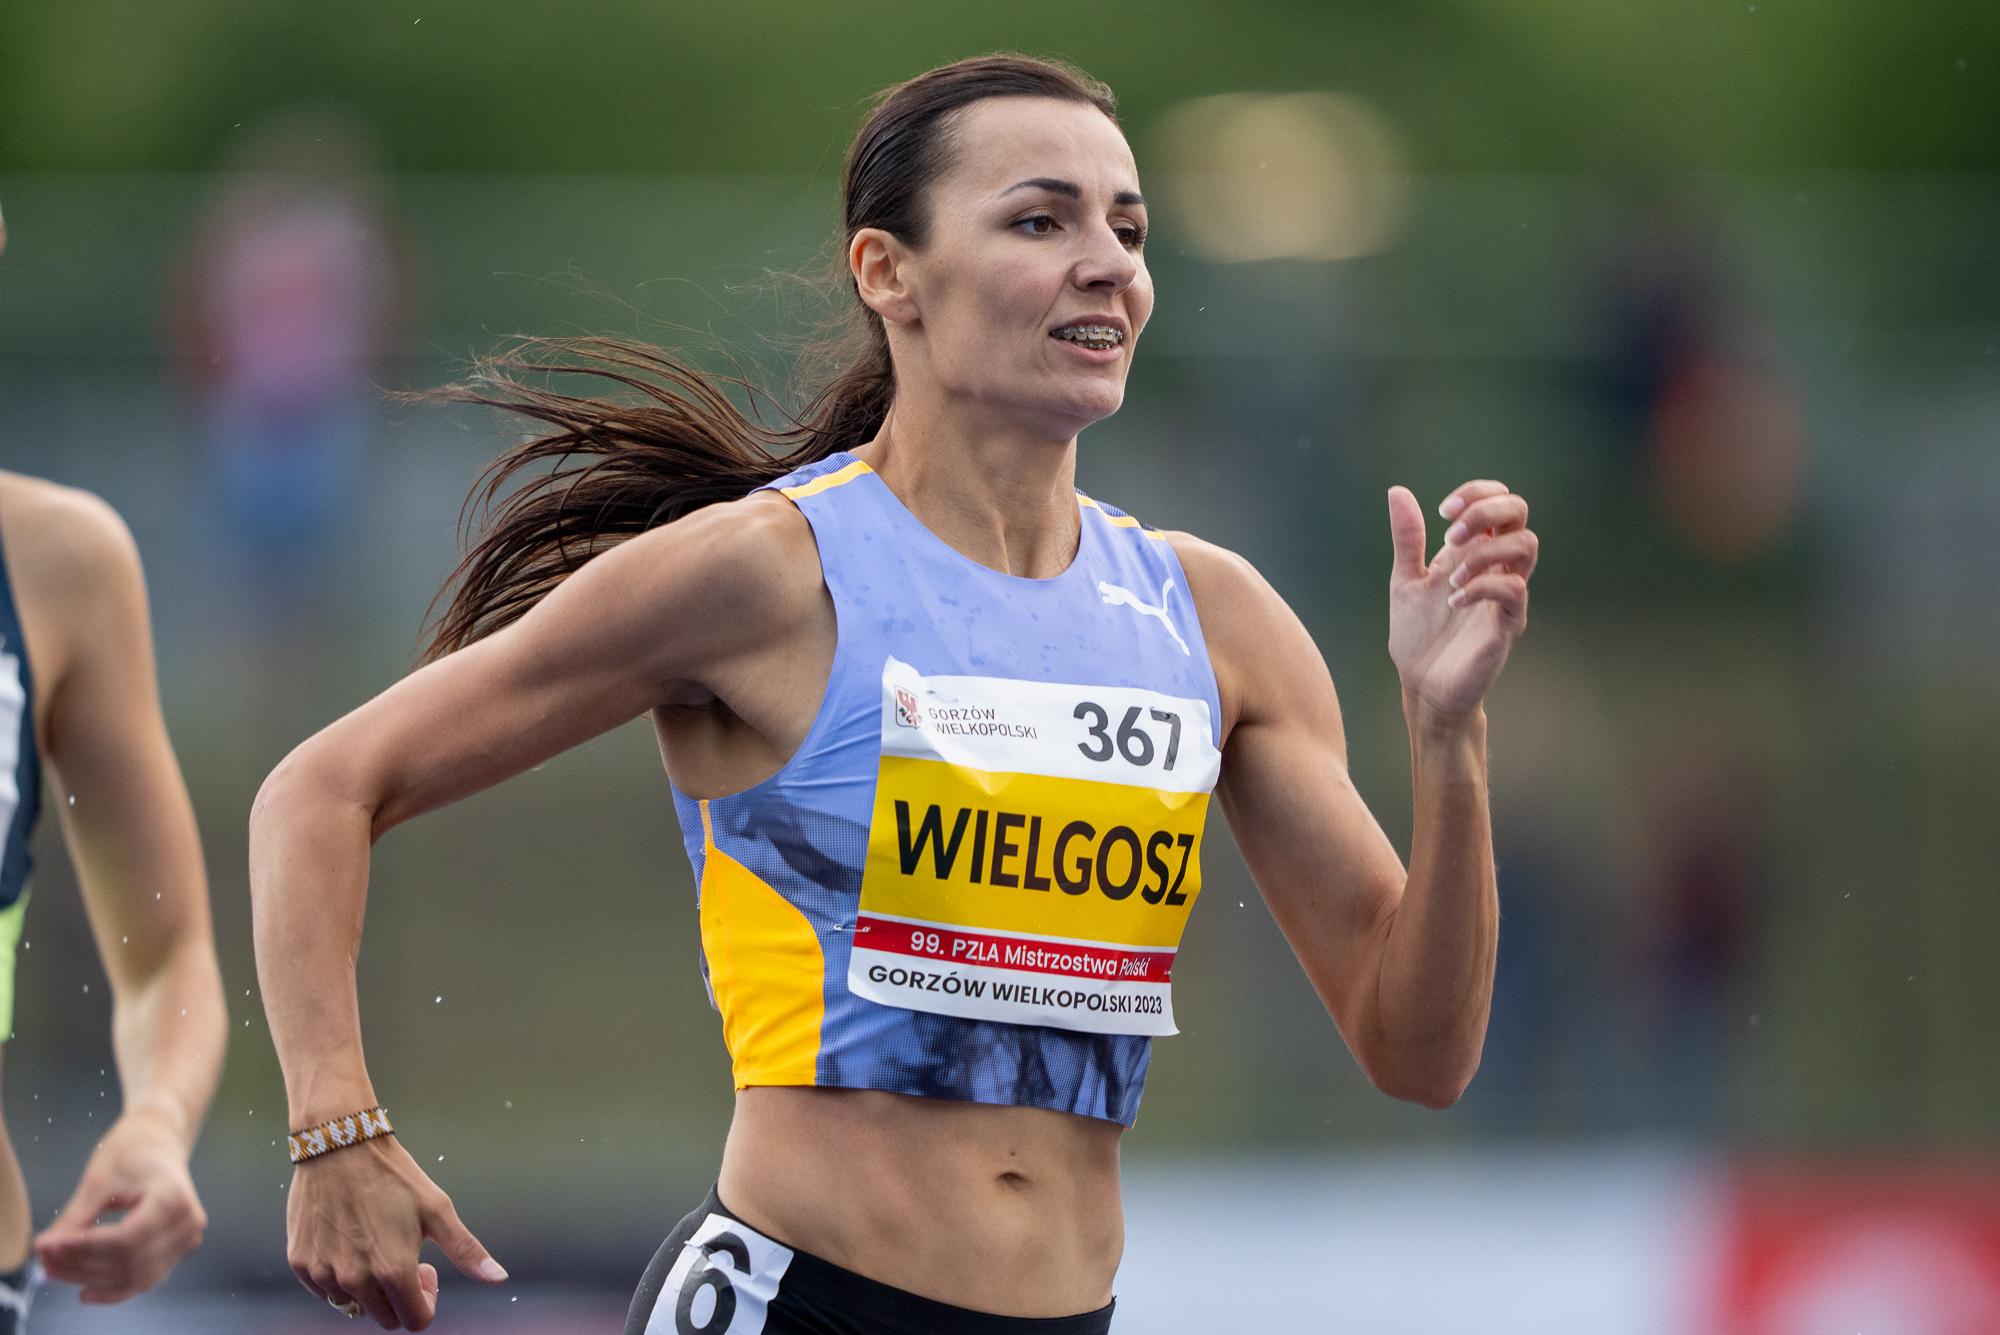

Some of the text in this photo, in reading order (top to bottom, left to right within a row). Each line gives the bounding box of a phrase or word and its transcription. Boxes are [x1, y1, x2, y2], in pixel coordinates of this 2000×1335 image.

[928, 705, 996, 721] GORZÓW
[932, 722, 1038, 740] WIELKOPOLSKI
[1073, 701, 1182, 771] 367
[894, 799, 1195, 906] WIELGOSZ
[910, 931, 1151, 977] 99. PZLA Mistrzostwa Polski
[868, 965, 1163, 1015] GORZÓW WIELKOPOLSKI 2023
[675, 1231, 751, 1335] 6
